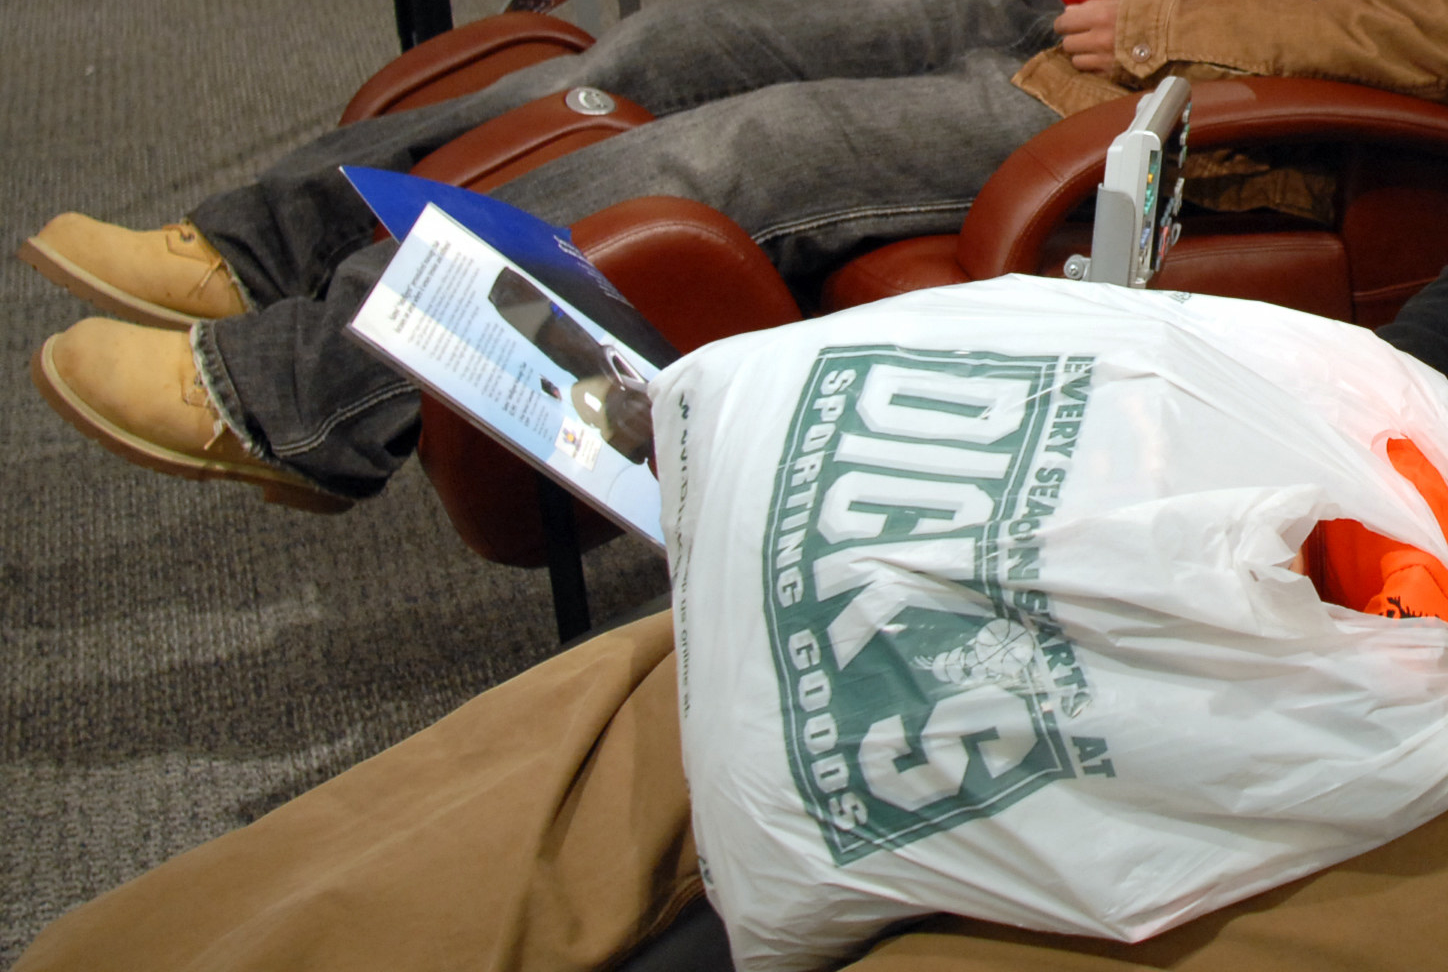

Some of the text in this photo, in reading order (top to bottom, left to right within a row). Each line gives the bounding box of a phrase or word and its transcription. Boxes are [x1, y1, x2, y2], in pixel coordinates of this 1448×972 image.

[1044, 355, 1097, 460] EVERY
[1007, 466, 1067, 581] SEAON
[776, 368, 869, 831] SPORTING GOODS
[1071, 735, 1117, 778] AT
